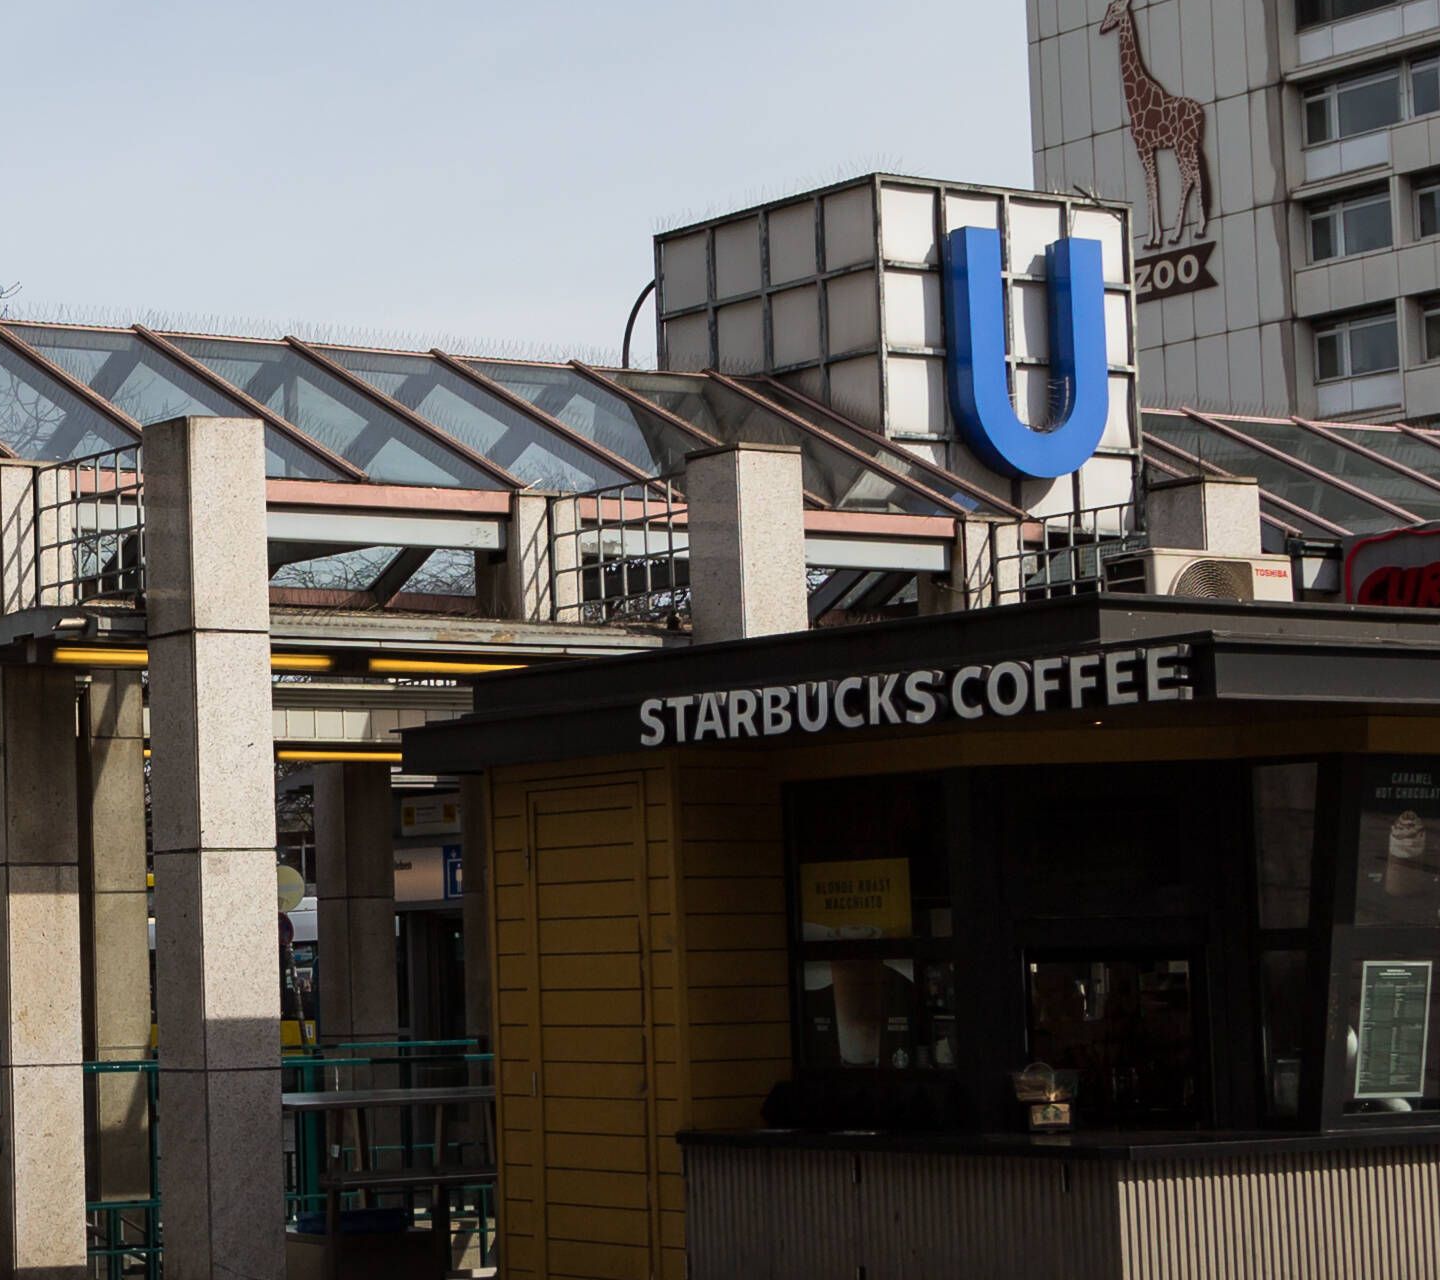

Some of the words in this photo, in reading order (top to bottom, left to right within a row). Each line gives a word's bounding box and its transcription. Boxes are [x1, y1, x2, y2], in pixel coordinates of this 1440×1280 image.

[1136, 254, 1199, 294] ZOO
[946, 226, 1110, 479] U
[1255, 568, 1288, 578] TOSHIBA
[640, 671, 938, 747] STARBUCKS
[952, 644, 1193, 718] COFFEE
[1391, 772, 1432, 785] CARAMEL
[1376, 787, 1392, 799] HOT
